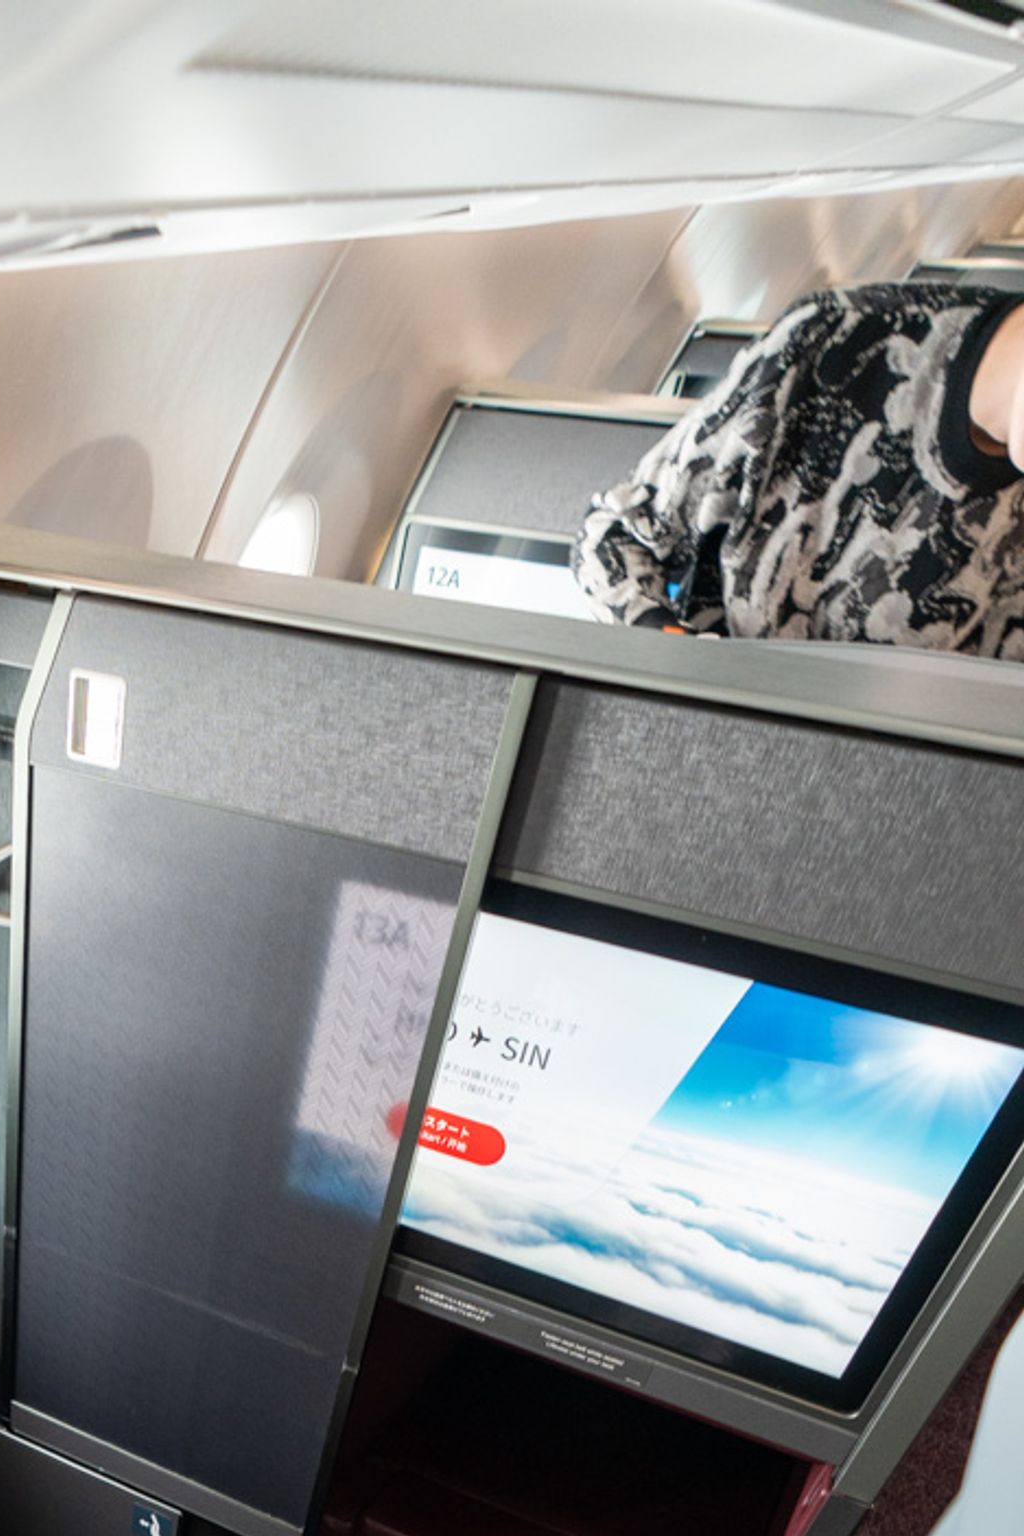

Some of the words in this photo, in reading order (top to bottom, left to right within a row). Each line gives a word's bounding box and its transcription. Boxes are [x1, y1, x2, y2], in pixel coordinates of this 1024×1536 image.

[428, 566, 460, 588] 12A
[500, 1036, 551, 1071] SIN
[424, 1115, 470, 1138] スタート
